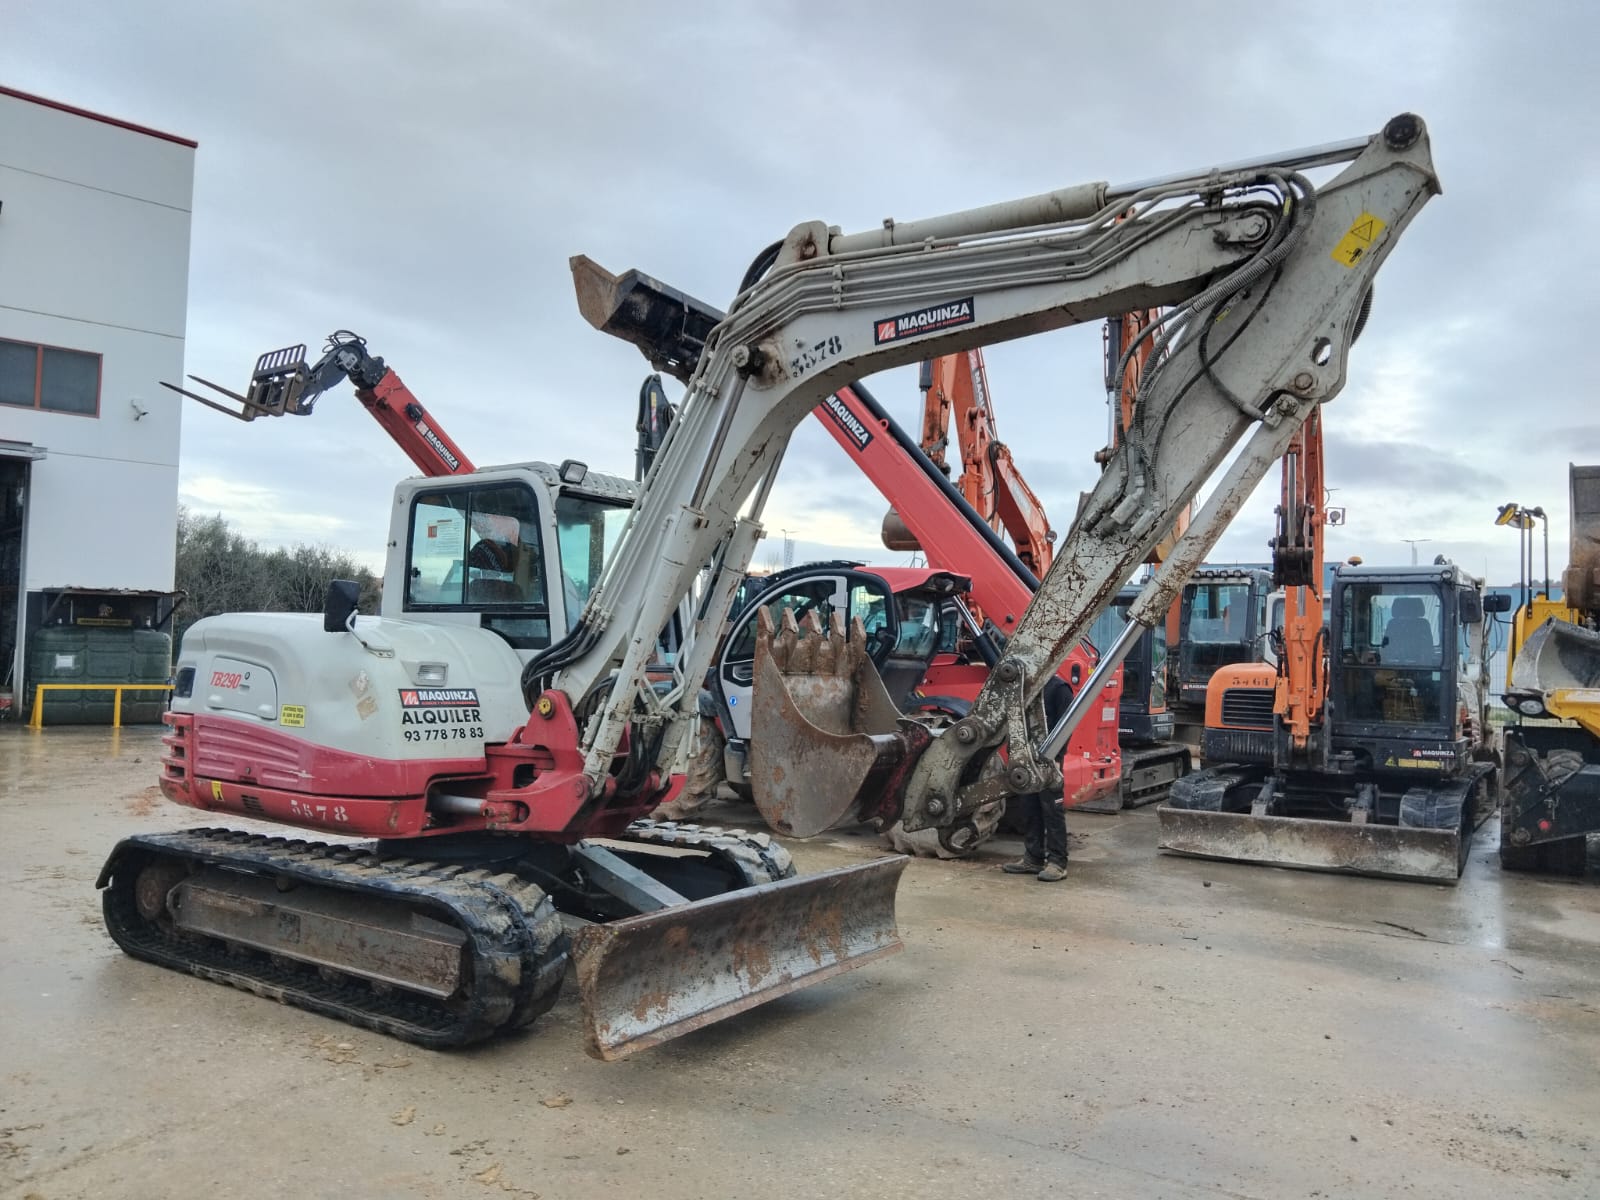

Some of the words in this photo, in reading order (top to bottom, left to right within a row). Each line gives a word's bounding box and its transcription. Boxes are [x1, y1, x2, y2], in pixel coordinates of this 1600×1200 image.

[898, 302, 970, 331] MAQUINZA
[825, 393, 869, 444] MAQUINZA
[426, 430, 458, 468] MAQUINZA
[210, 671, 242, 689] TB290
[418, 691, 476, 701] MAQUINZA
[402, 709, 482, 724] ALQUILER
[404, 730, 421, 742] 93
[425, 729, 448, 740] 778
[451, 728, 466, 739] 78
[469, 727, 484, 738] 83
